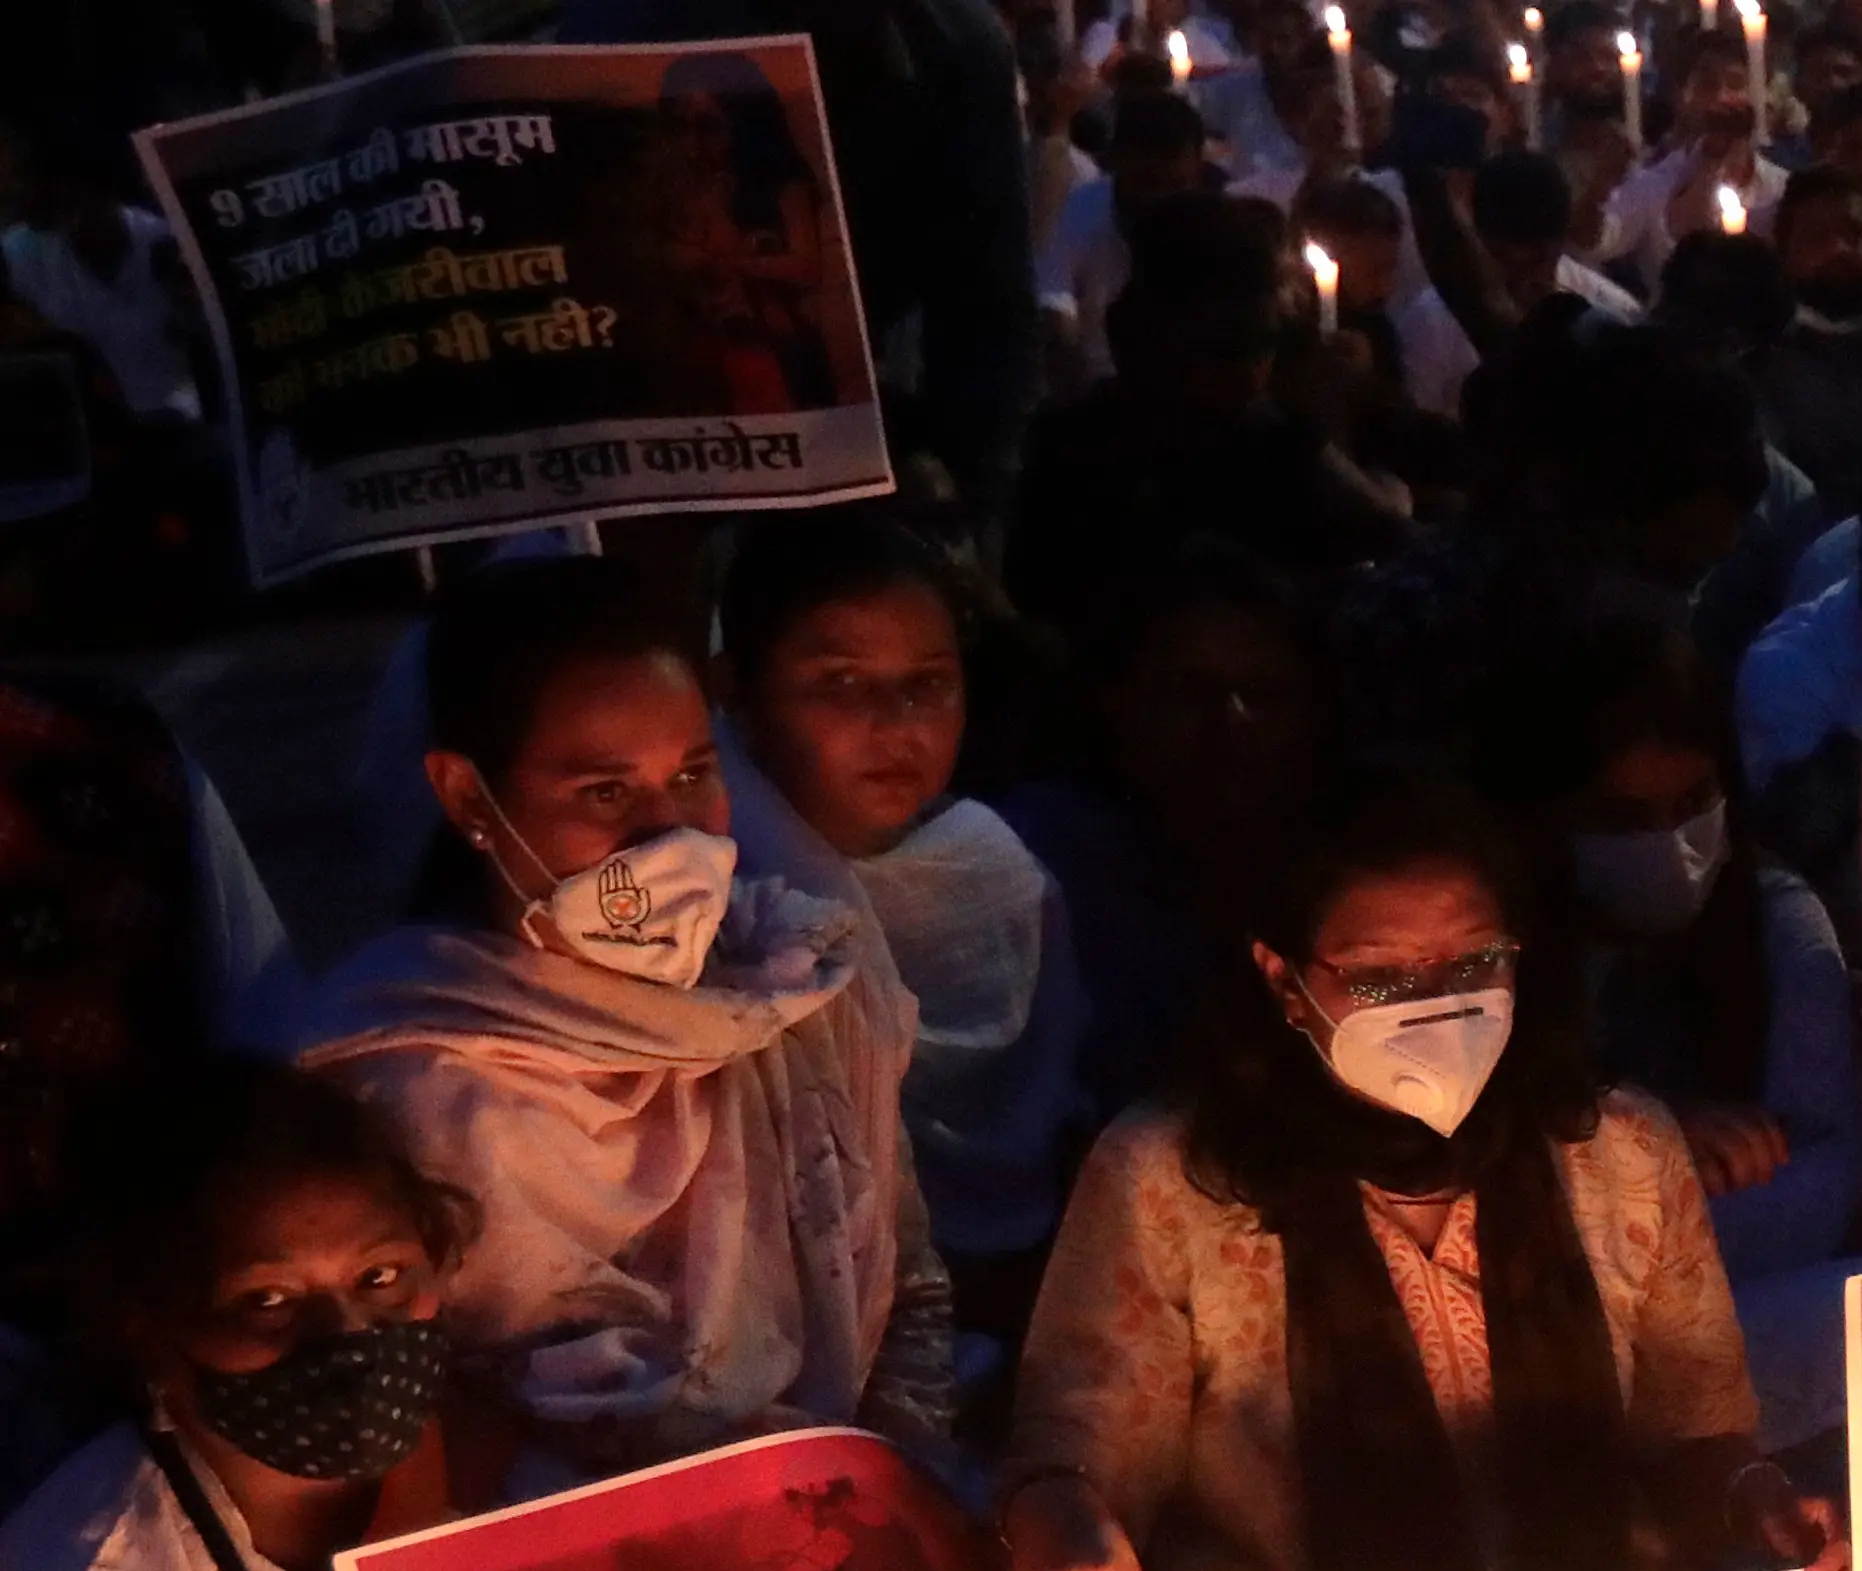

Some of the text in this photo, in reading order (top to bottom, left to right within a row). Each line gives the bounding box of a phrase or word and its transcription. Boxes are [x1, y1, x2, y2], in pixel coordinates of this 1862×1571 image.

[210, 114, 556, 228] 9 साल की मासूम
[228, 178, 487, 290] जला दी गयी,
[427, 309, 492, 364] भी
[495, 296, 620, 353] नही?
[343, 422, 805, 513] भारतीय युवा कांग्रेस
